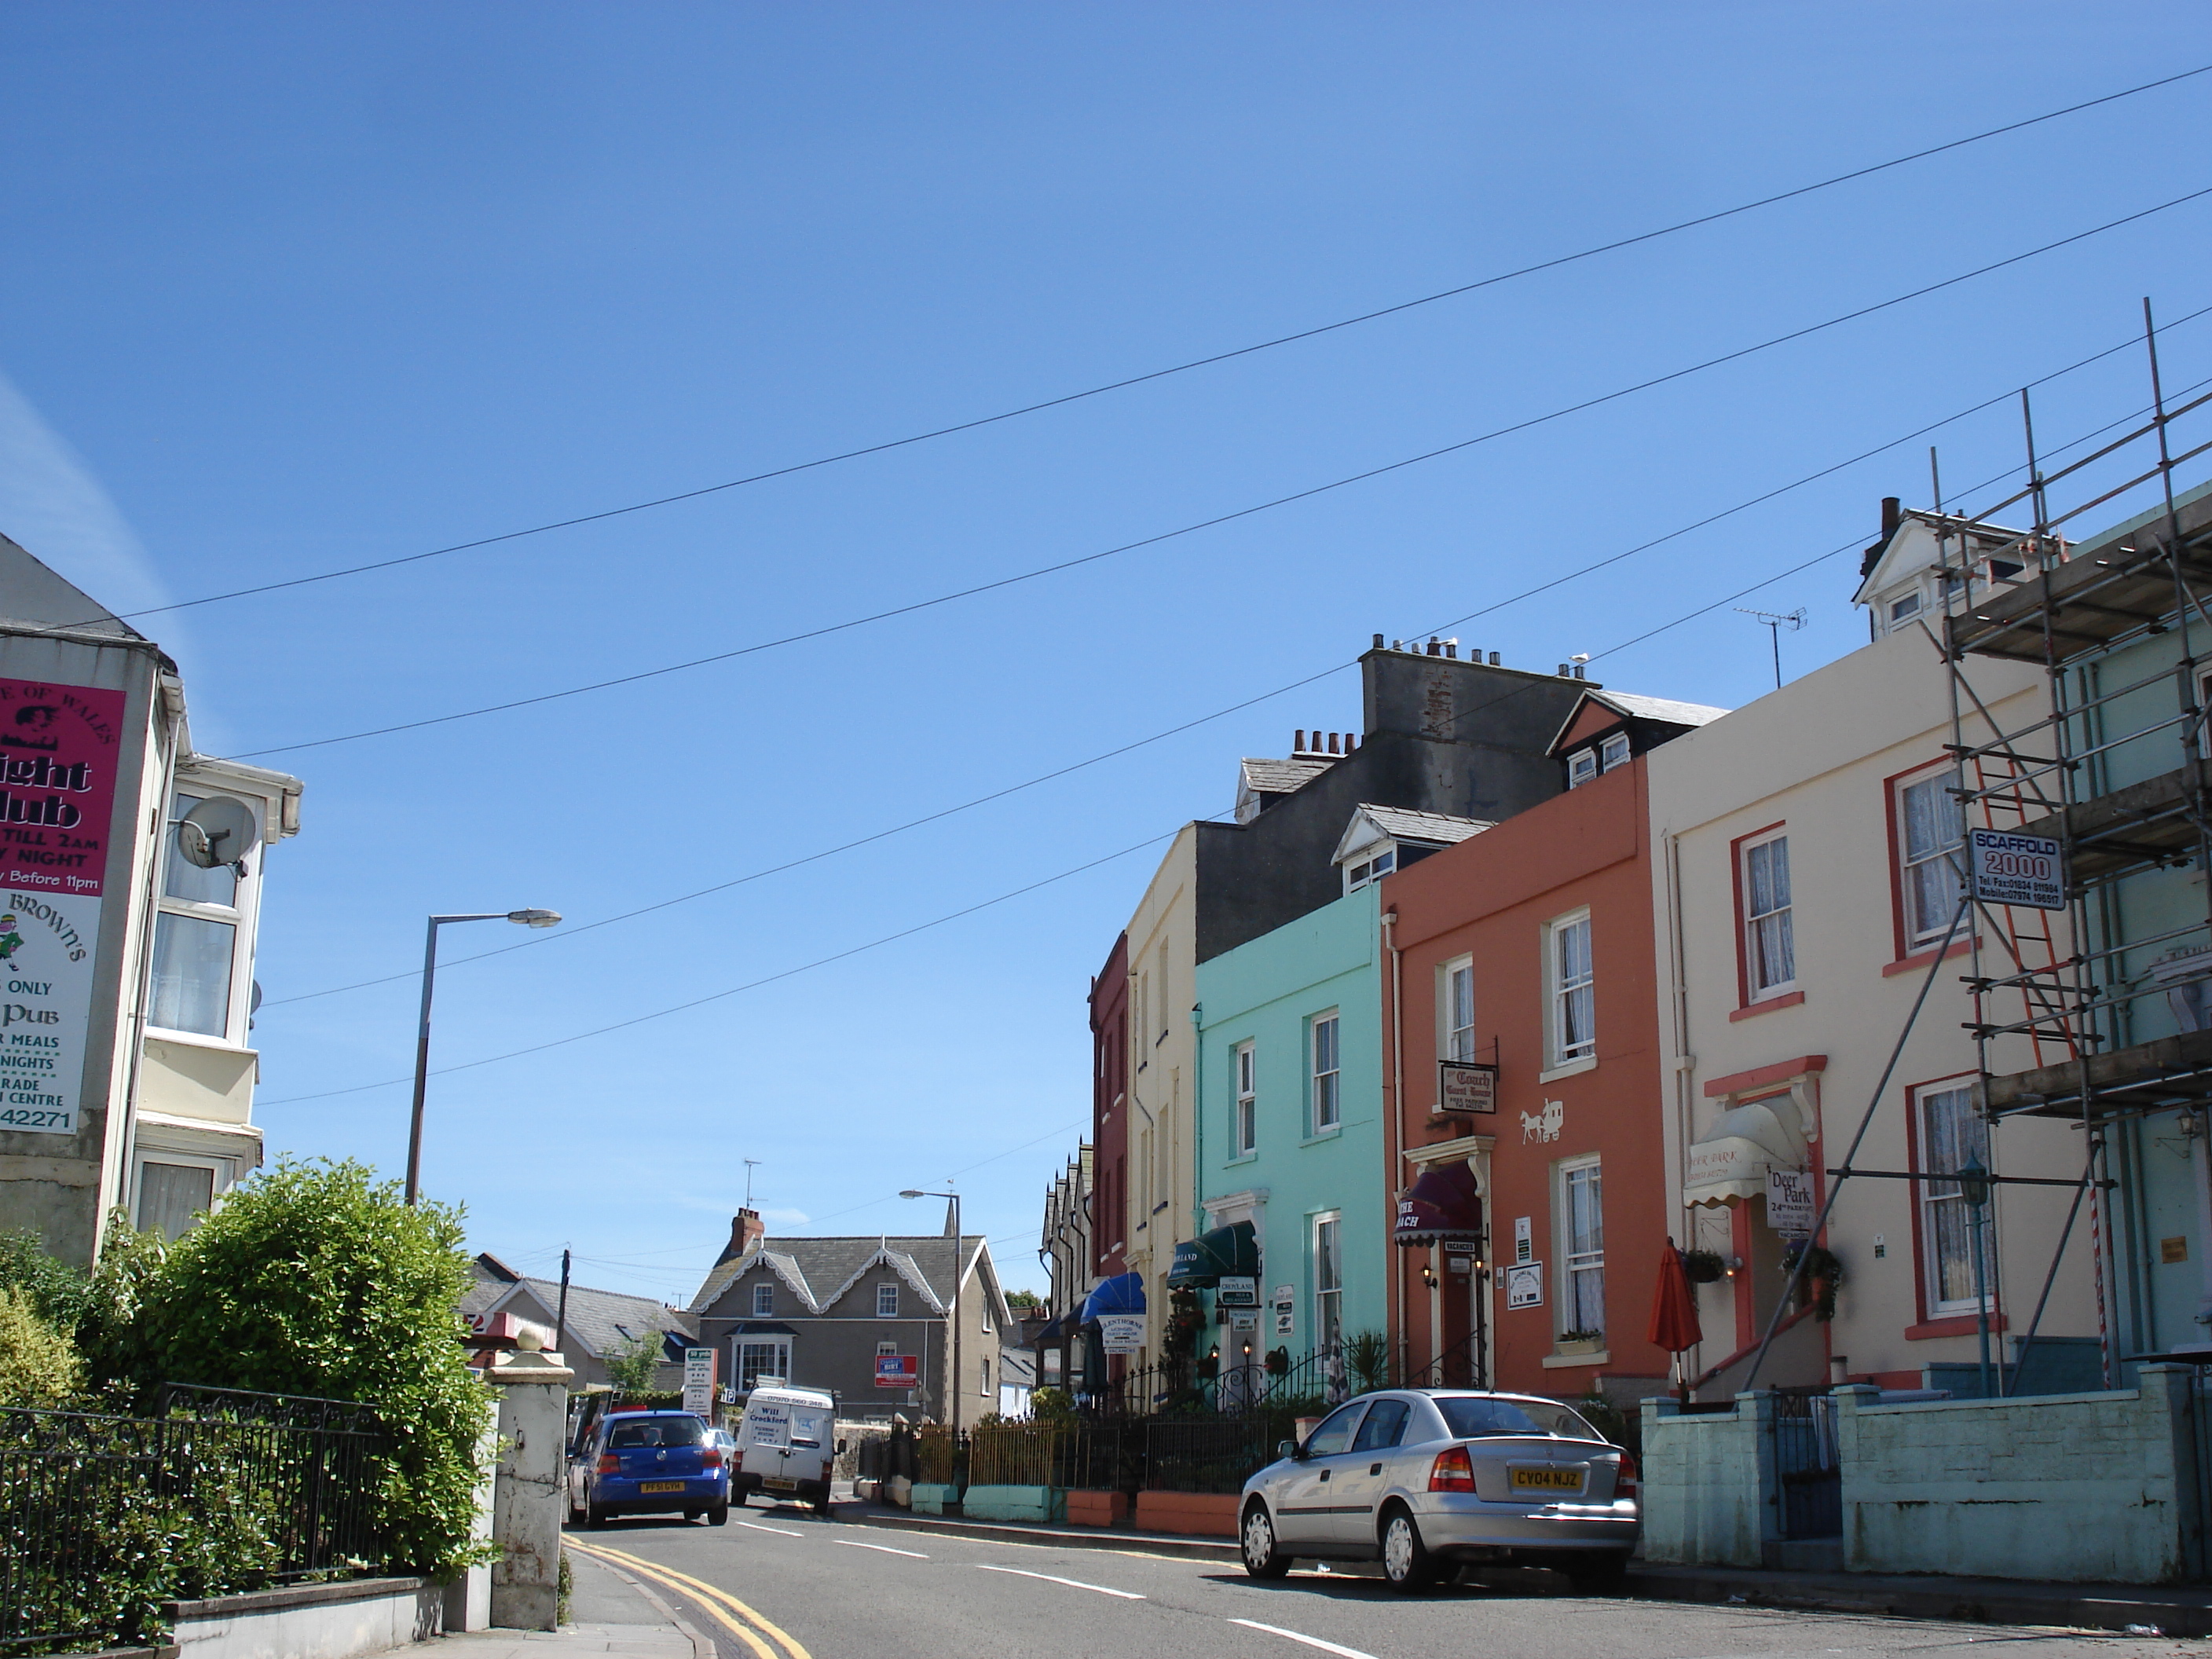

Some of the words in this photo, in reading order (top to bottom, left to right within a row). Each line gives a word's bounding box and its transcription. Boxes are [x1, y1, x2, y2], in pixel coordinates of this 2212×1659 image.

[24, 685, 52, 701] OF
[62, 694, 116, 745] WALES
[2, 828, 47, 846] TILL
[1976, 833, 2056, 855] SCAFFOLD
[17, 849, 88, 868] NIGHT
[1985, 850, 2051, 881] 2000
[9, 870, 60, 887] Before
[66, 874, 99, 892] 11pm
[8, 980, 53, 995] ONLY
[11, 1034, 60, 1049] MEALS
[0, 1055, 54, 1070] NIGHTS
[9, 1092, 64, 1107] CENTRE
[1772, 1172, 1798, 1188] Deer
[1784, 1187, 1811, 1203] Park
[1446, 1242, 1474, 1251] VACANCIES
[1102, 1318, 1144, 1331] GLENTHORNE
[761, 1407, 779, 1416] Will
[1518, 1471, 1551, 1485] CV04
[1554, 1473, 1577, 1486] NJZ
